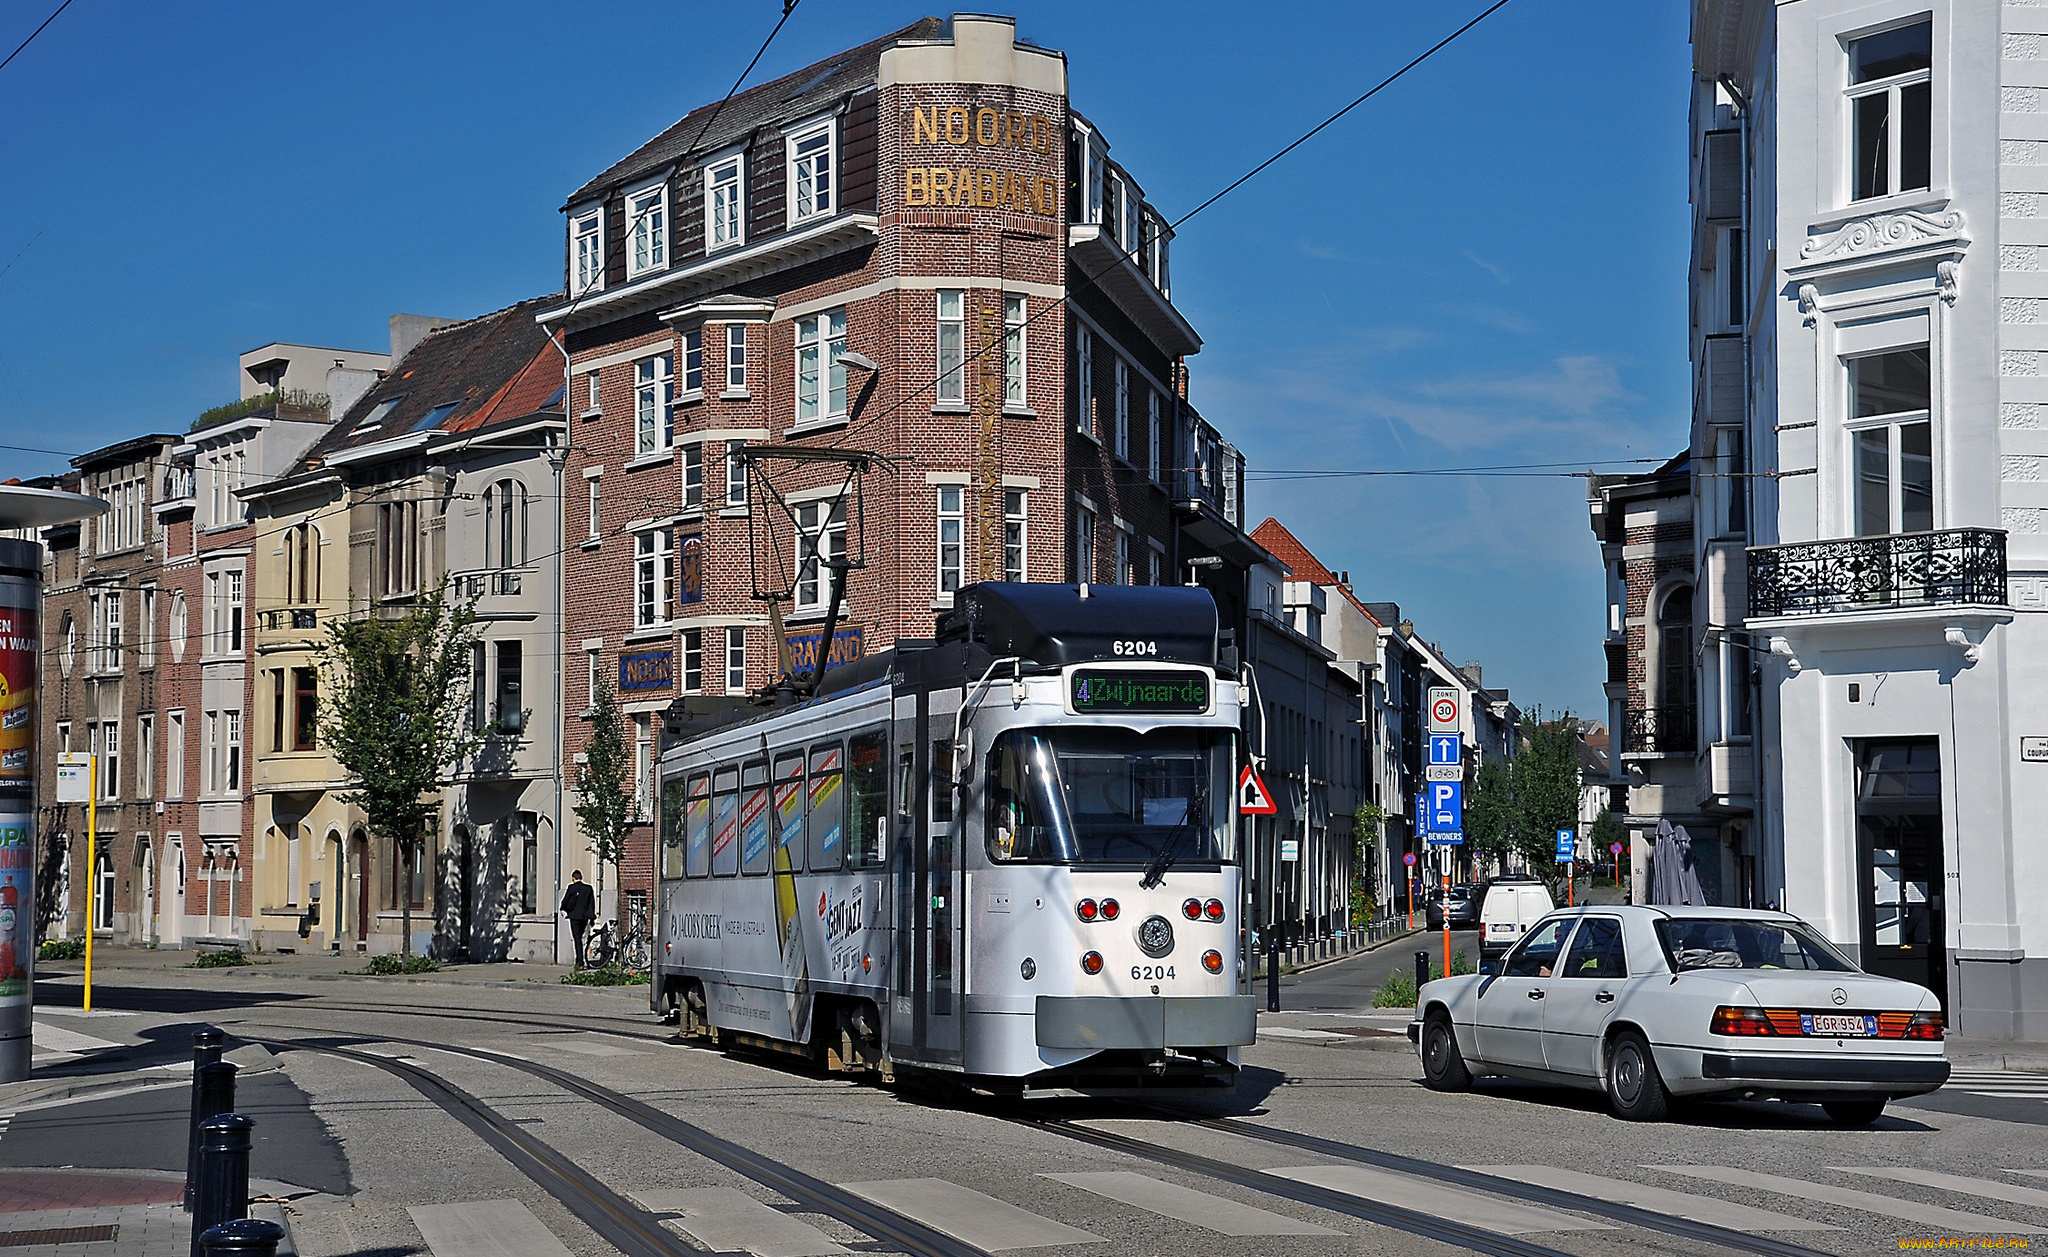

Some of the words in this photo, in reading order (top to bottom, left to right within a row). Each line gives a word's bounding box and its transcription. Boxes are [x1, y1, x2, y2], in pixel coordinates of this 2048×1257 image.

[913, 106, 1051, 154] NOORD
[906, 168, 1056, 216] BRABAND
[1113, 641, 1158, 655] 6204
[1077, 678, 1091, 702] 4
[1093, 678, 1205, 706] Zwijnaarde
[1438, 706, 1451, 716] 30
[1436, 785, 1454, 810] P
[0, 828, 29, 847] PA
[1428, 832, 1462, 841] BEWONERS
[1561, 832, 1570, 844] P
[701, 914, 721, 940] CREEK
[829, 899, 846, 940] GENT
[845, 897, 863, 940] JAZZ
[1130, 965, 1176, 980] 6204
